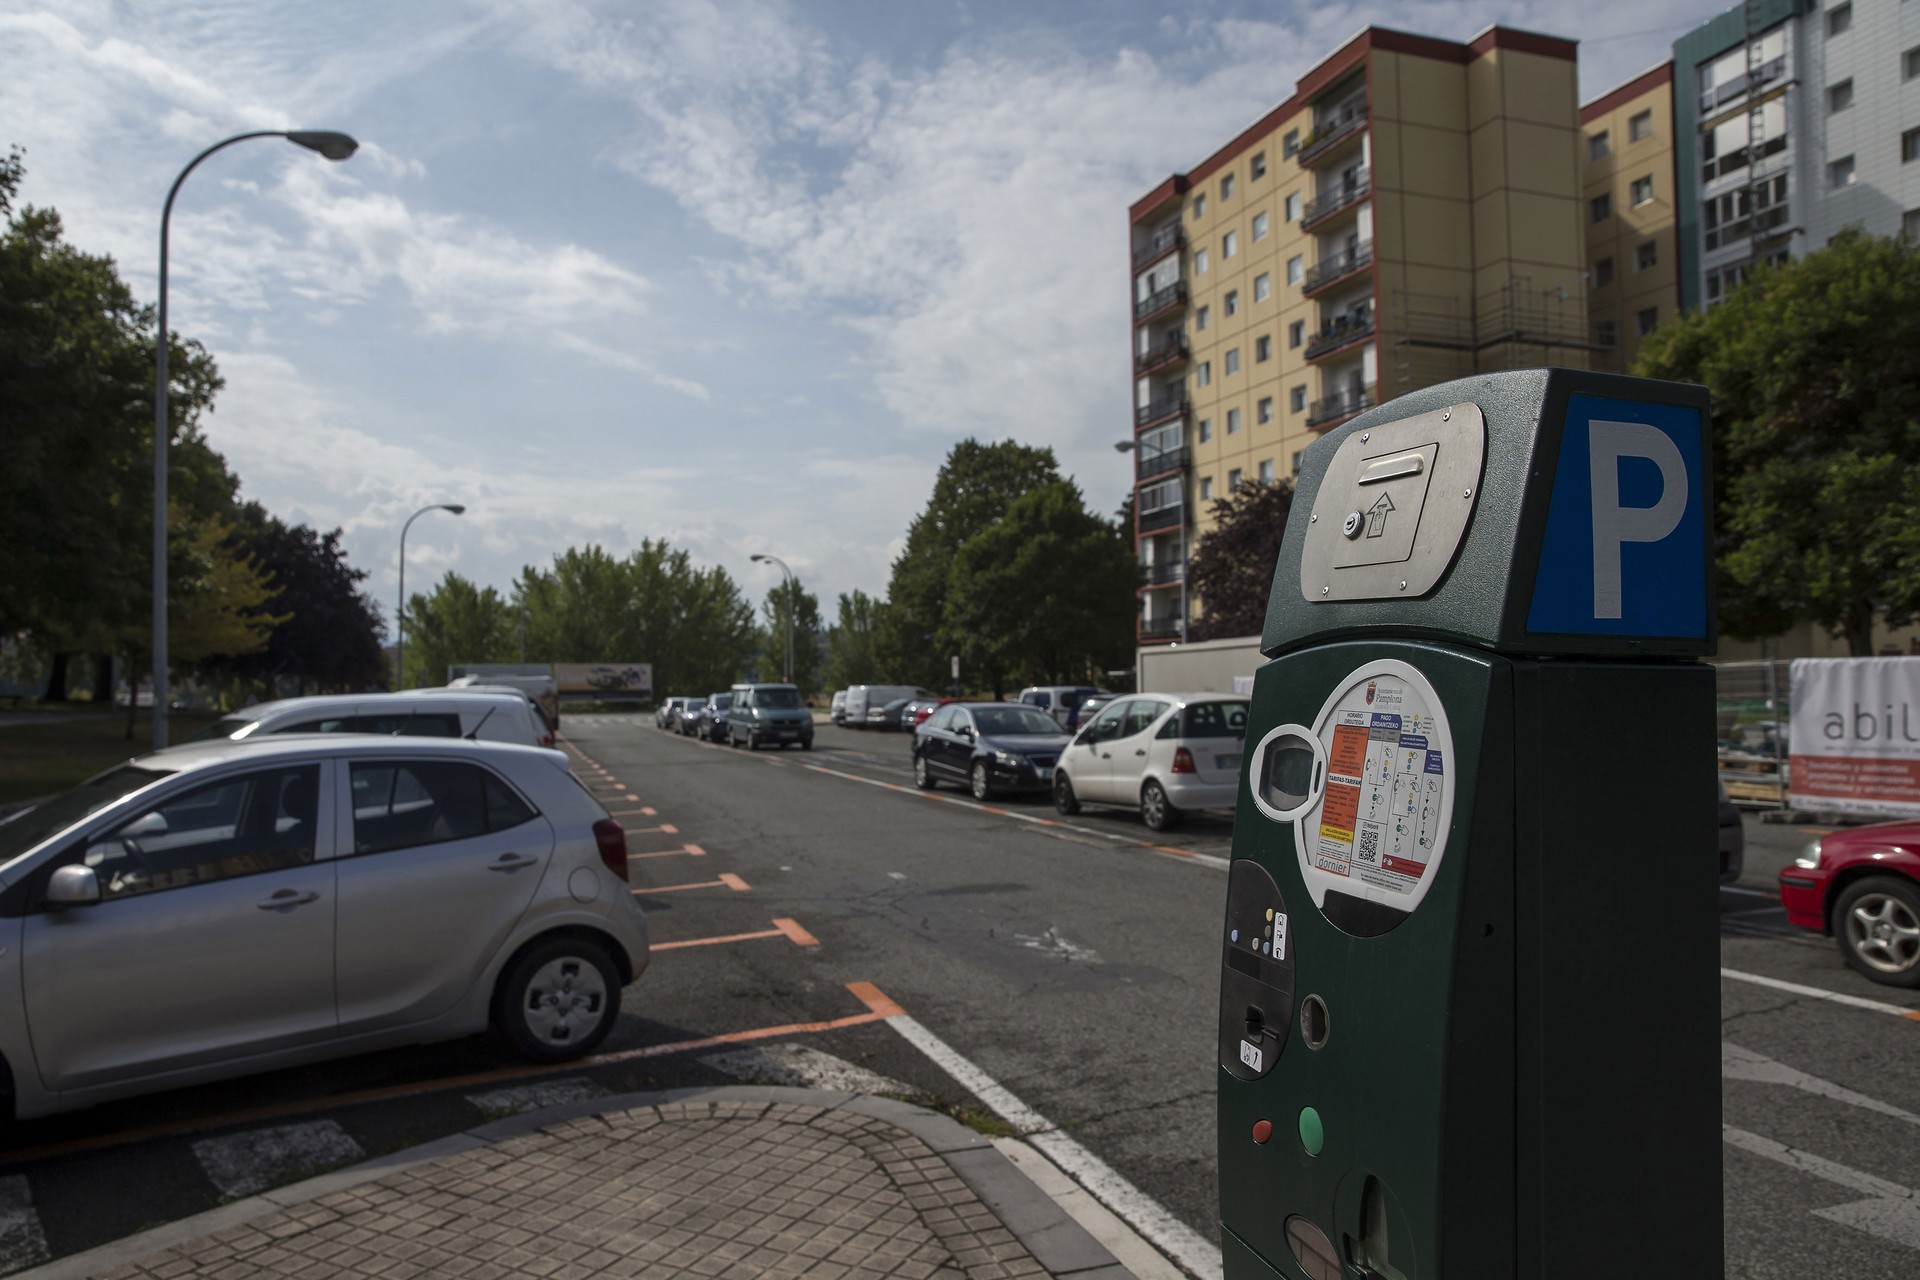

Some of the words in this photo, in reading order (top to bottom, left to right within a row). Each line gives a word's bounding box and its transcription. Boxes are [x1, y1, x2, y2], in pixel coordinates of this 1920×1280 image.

[1589, 420, 1688, 619] P
[1375, 693, 1402, 705] Pamplona
[1318, 857, 1347, 874] dornier
